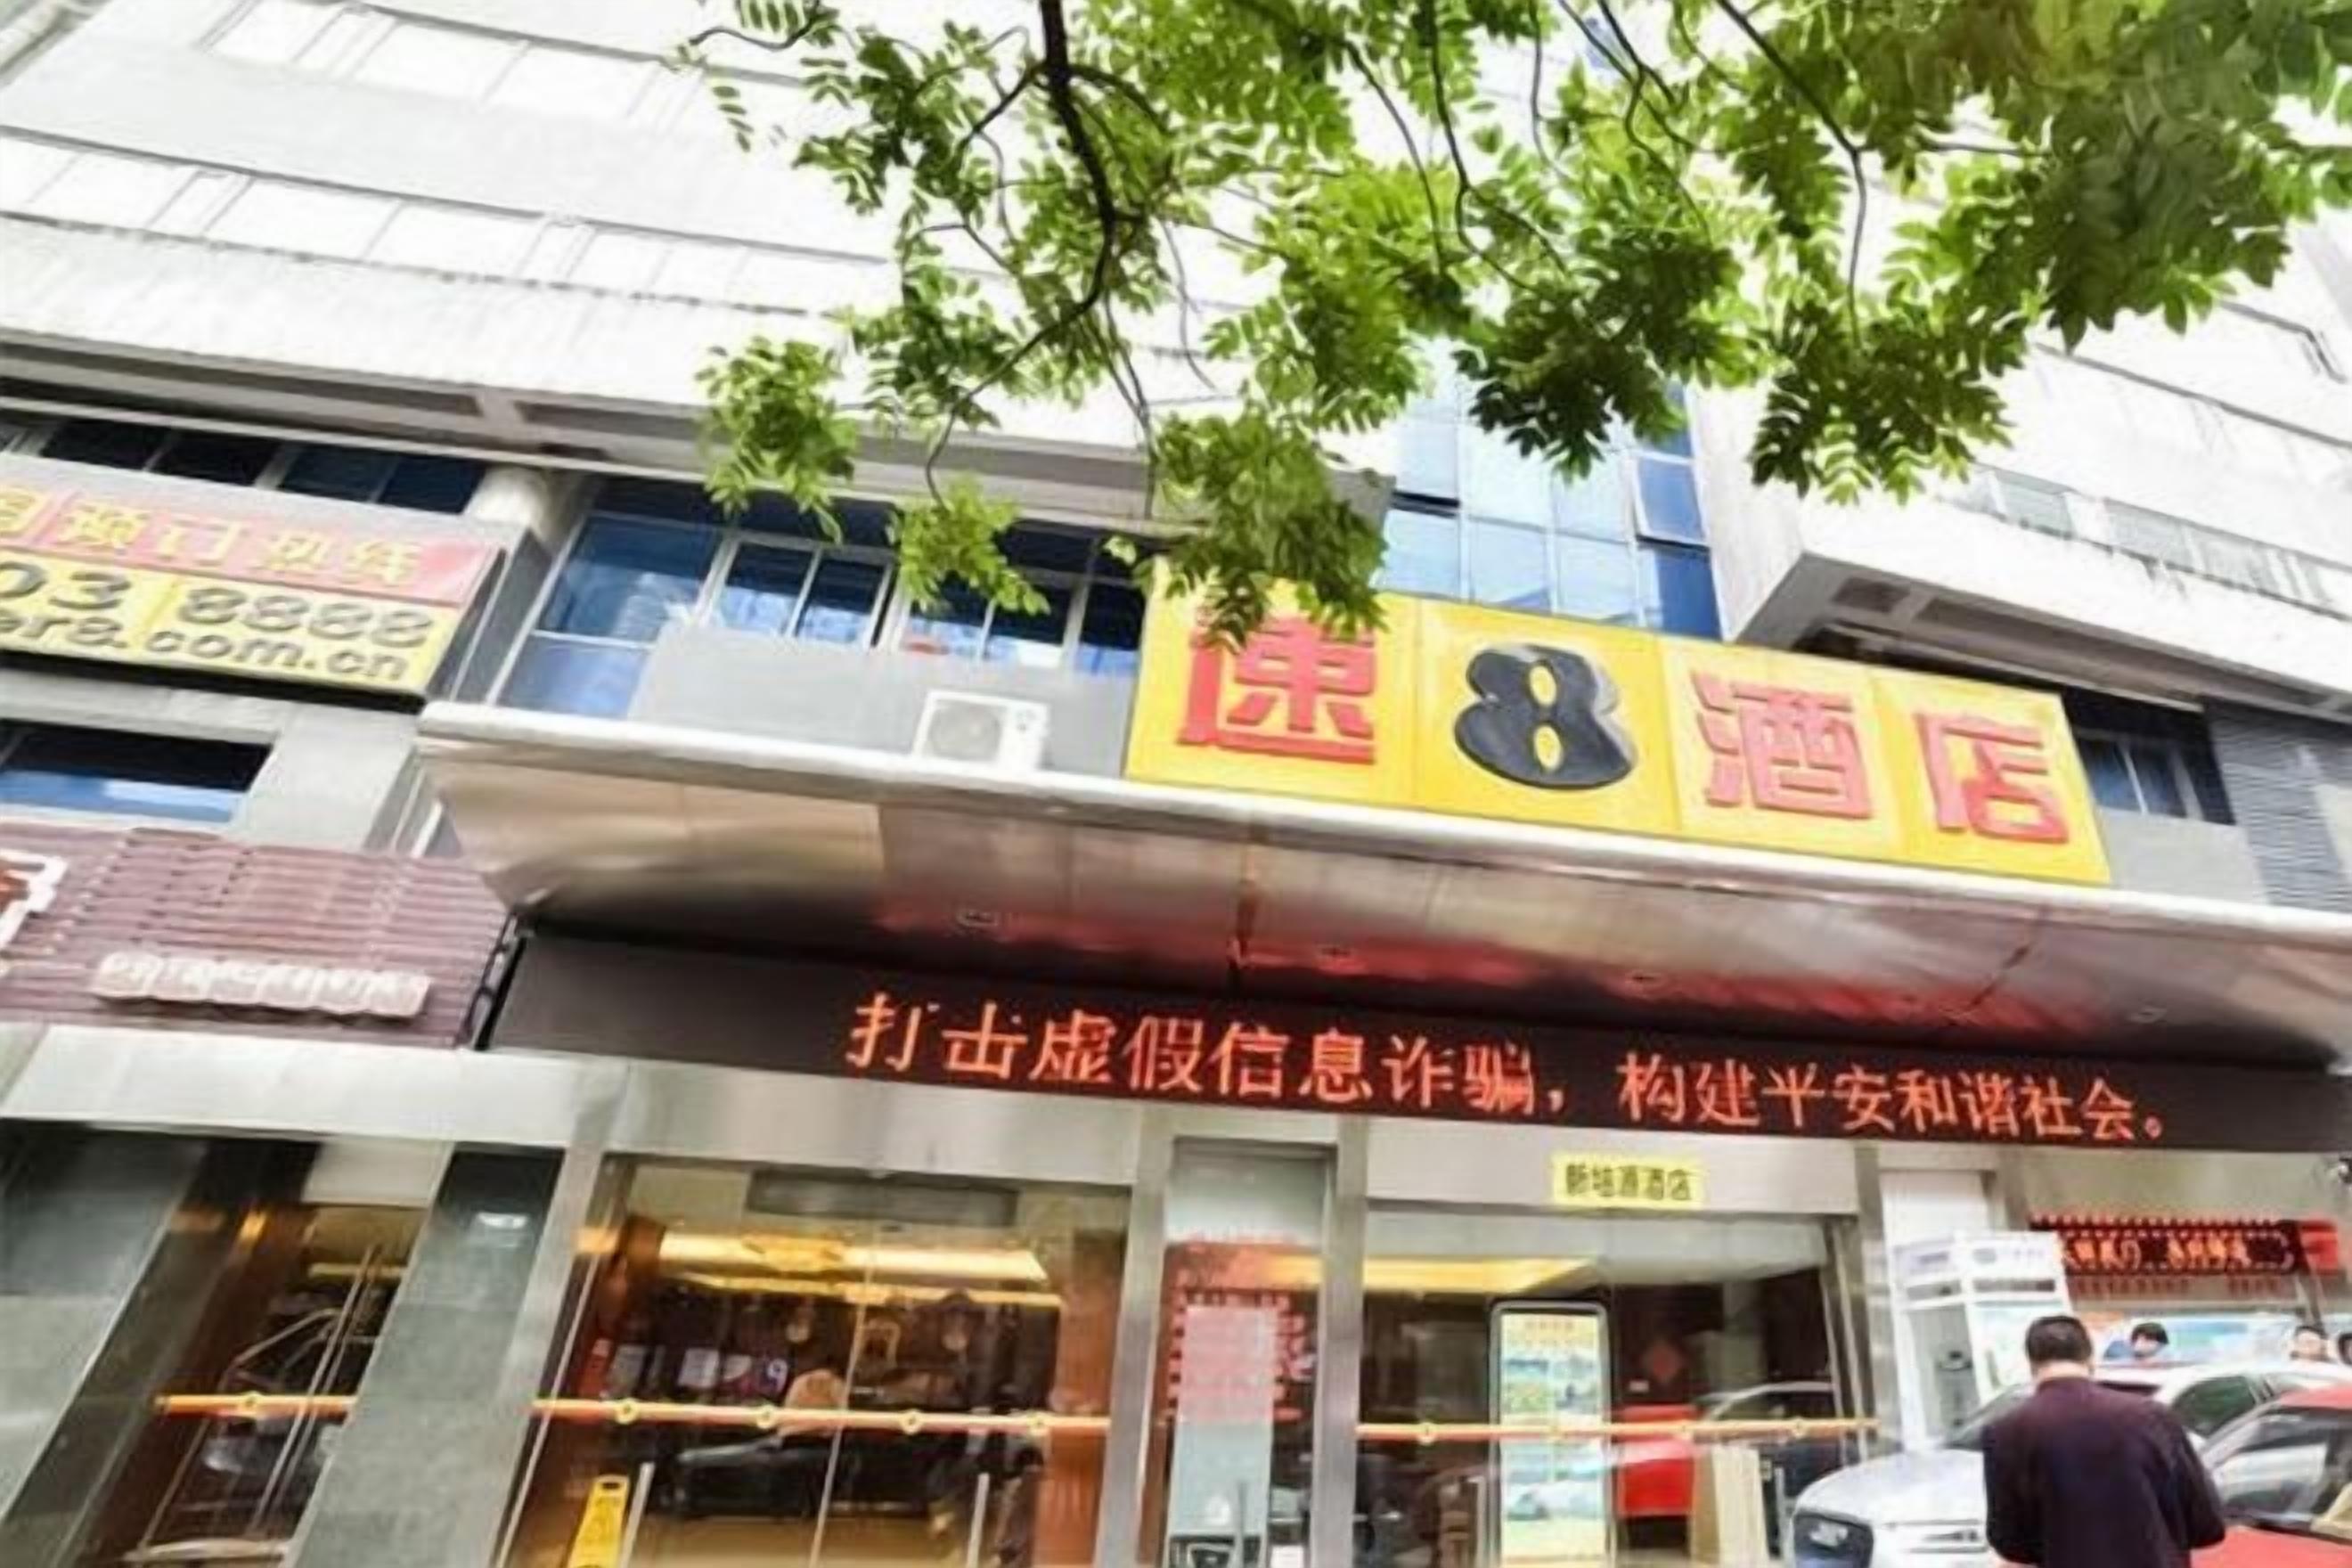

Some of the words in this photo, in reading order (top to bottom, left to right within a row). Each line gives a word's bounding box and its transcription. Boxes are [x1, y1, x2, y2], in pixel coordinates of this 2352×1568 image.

[179, 588, 433, 648] 8888
[1176, 608, 2069, 845] 速8酒店
